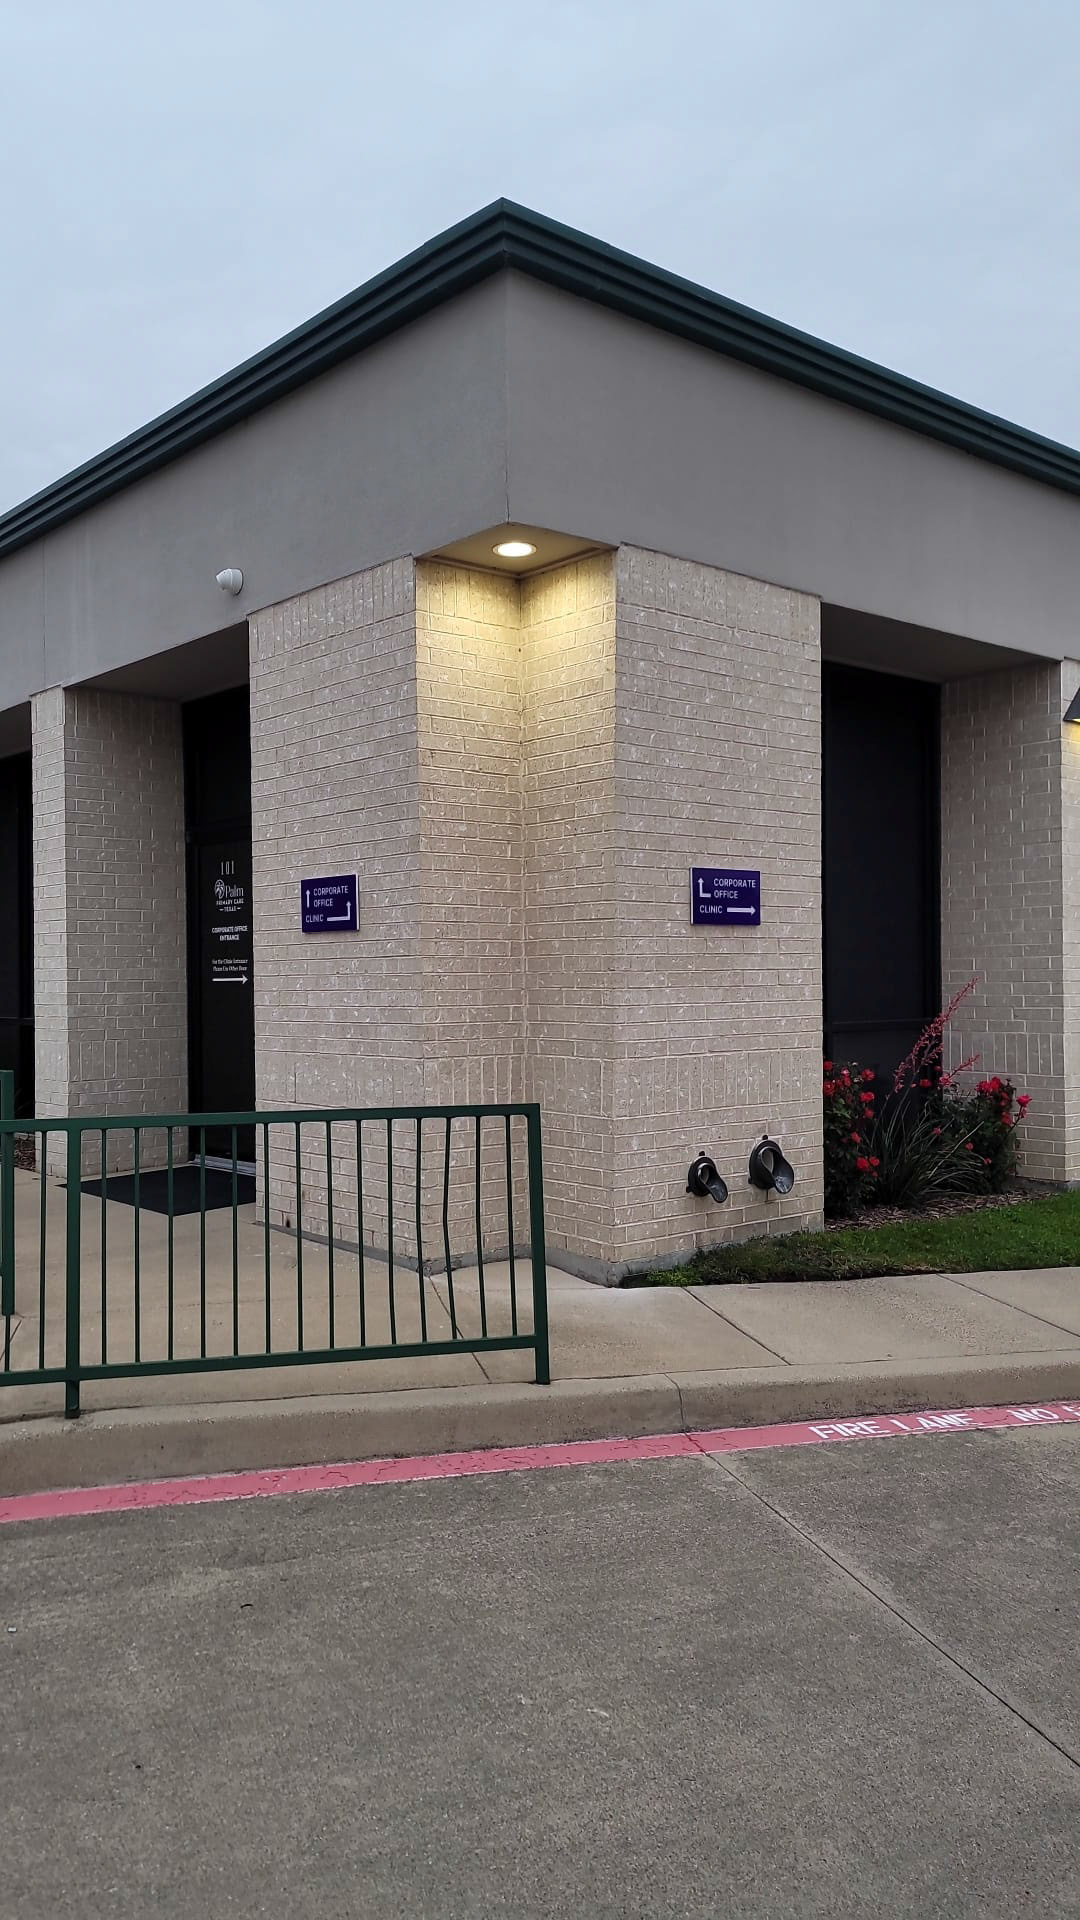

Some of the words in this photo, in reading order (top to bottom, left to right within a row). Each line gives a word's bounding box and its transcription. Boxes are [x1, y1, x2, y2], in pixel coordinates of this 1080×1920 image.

[221, 861, 234, 875] 101
[713, 878, 757, 888] CORPORATE
[225, 885, 244, 898] Palm
[313, 885, 349, 896] CORPORATE
[713, 889, 739, 899] OFFICE
[313, 898, 334, 908] OFFICE
[699, 904, 723, 914] CLINIC
[305, 914, 324, 923] CLINIC
[807, 1420, 891, 1439] FIRE
[890, 1413, 984, 1432] LANE
[1006, 1408, 1060, 1422] NO
